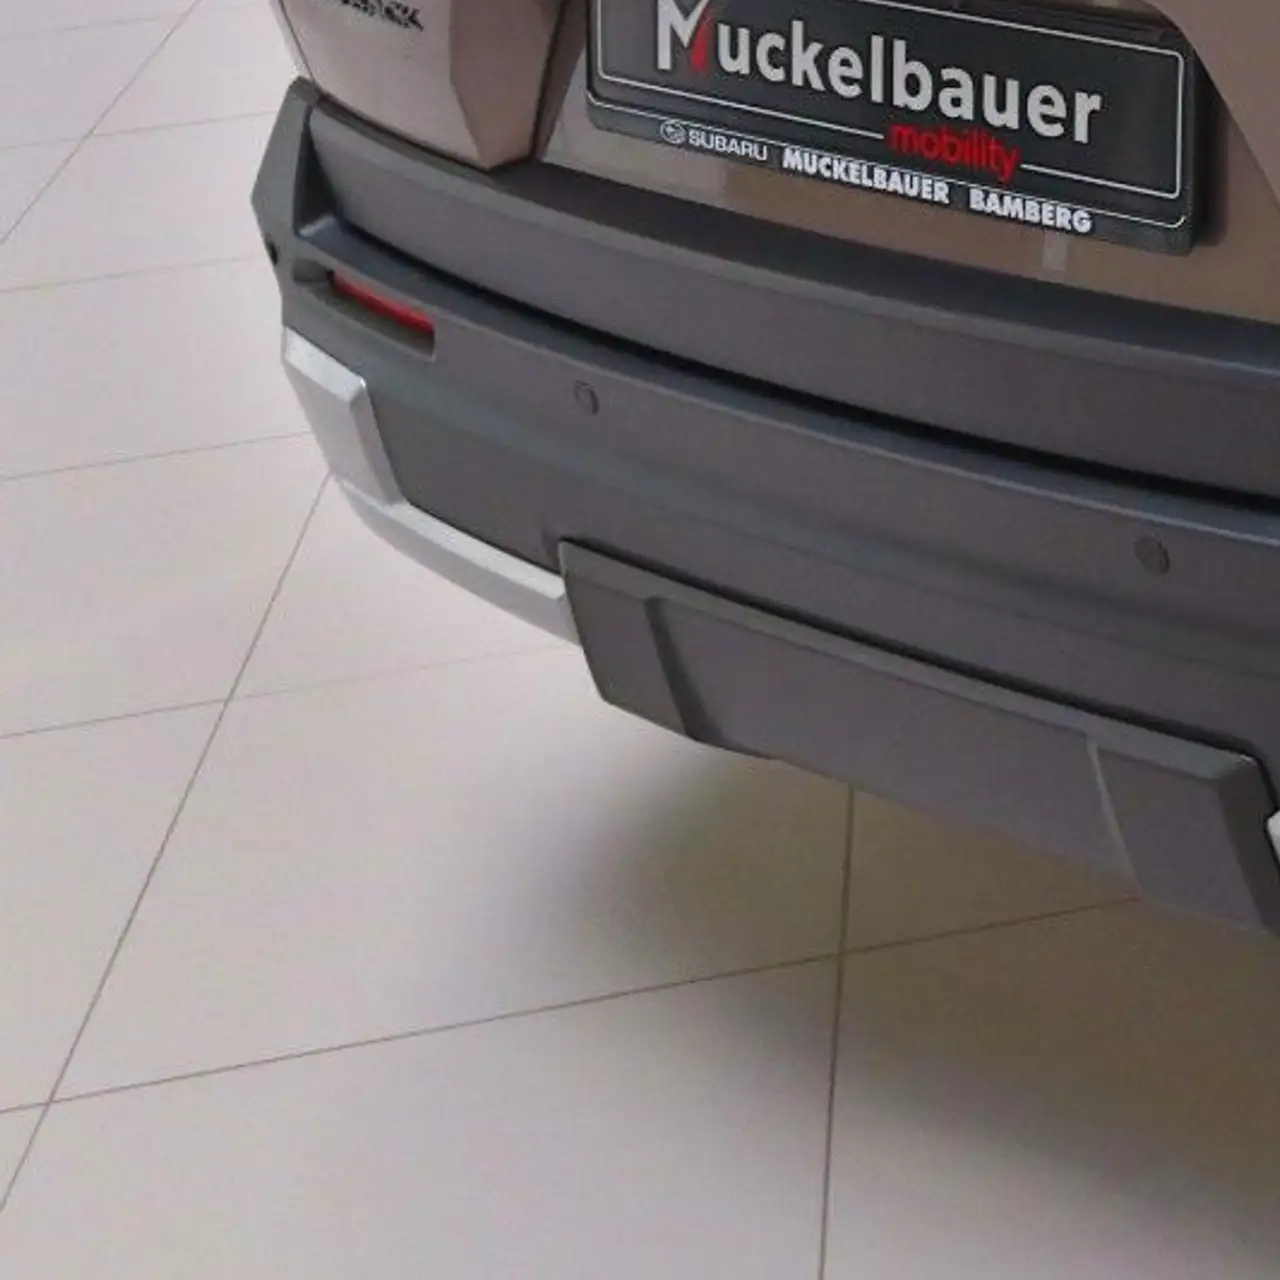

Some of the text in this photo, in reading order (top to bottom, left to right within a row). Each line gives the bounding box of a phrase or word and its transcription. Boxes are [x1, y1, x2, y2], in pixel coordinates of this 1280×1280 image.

[687, 128, 1093, 235] SUBARU MUCKELBAUER BAMBERG
[888, 123, 1021, 182] mobility
